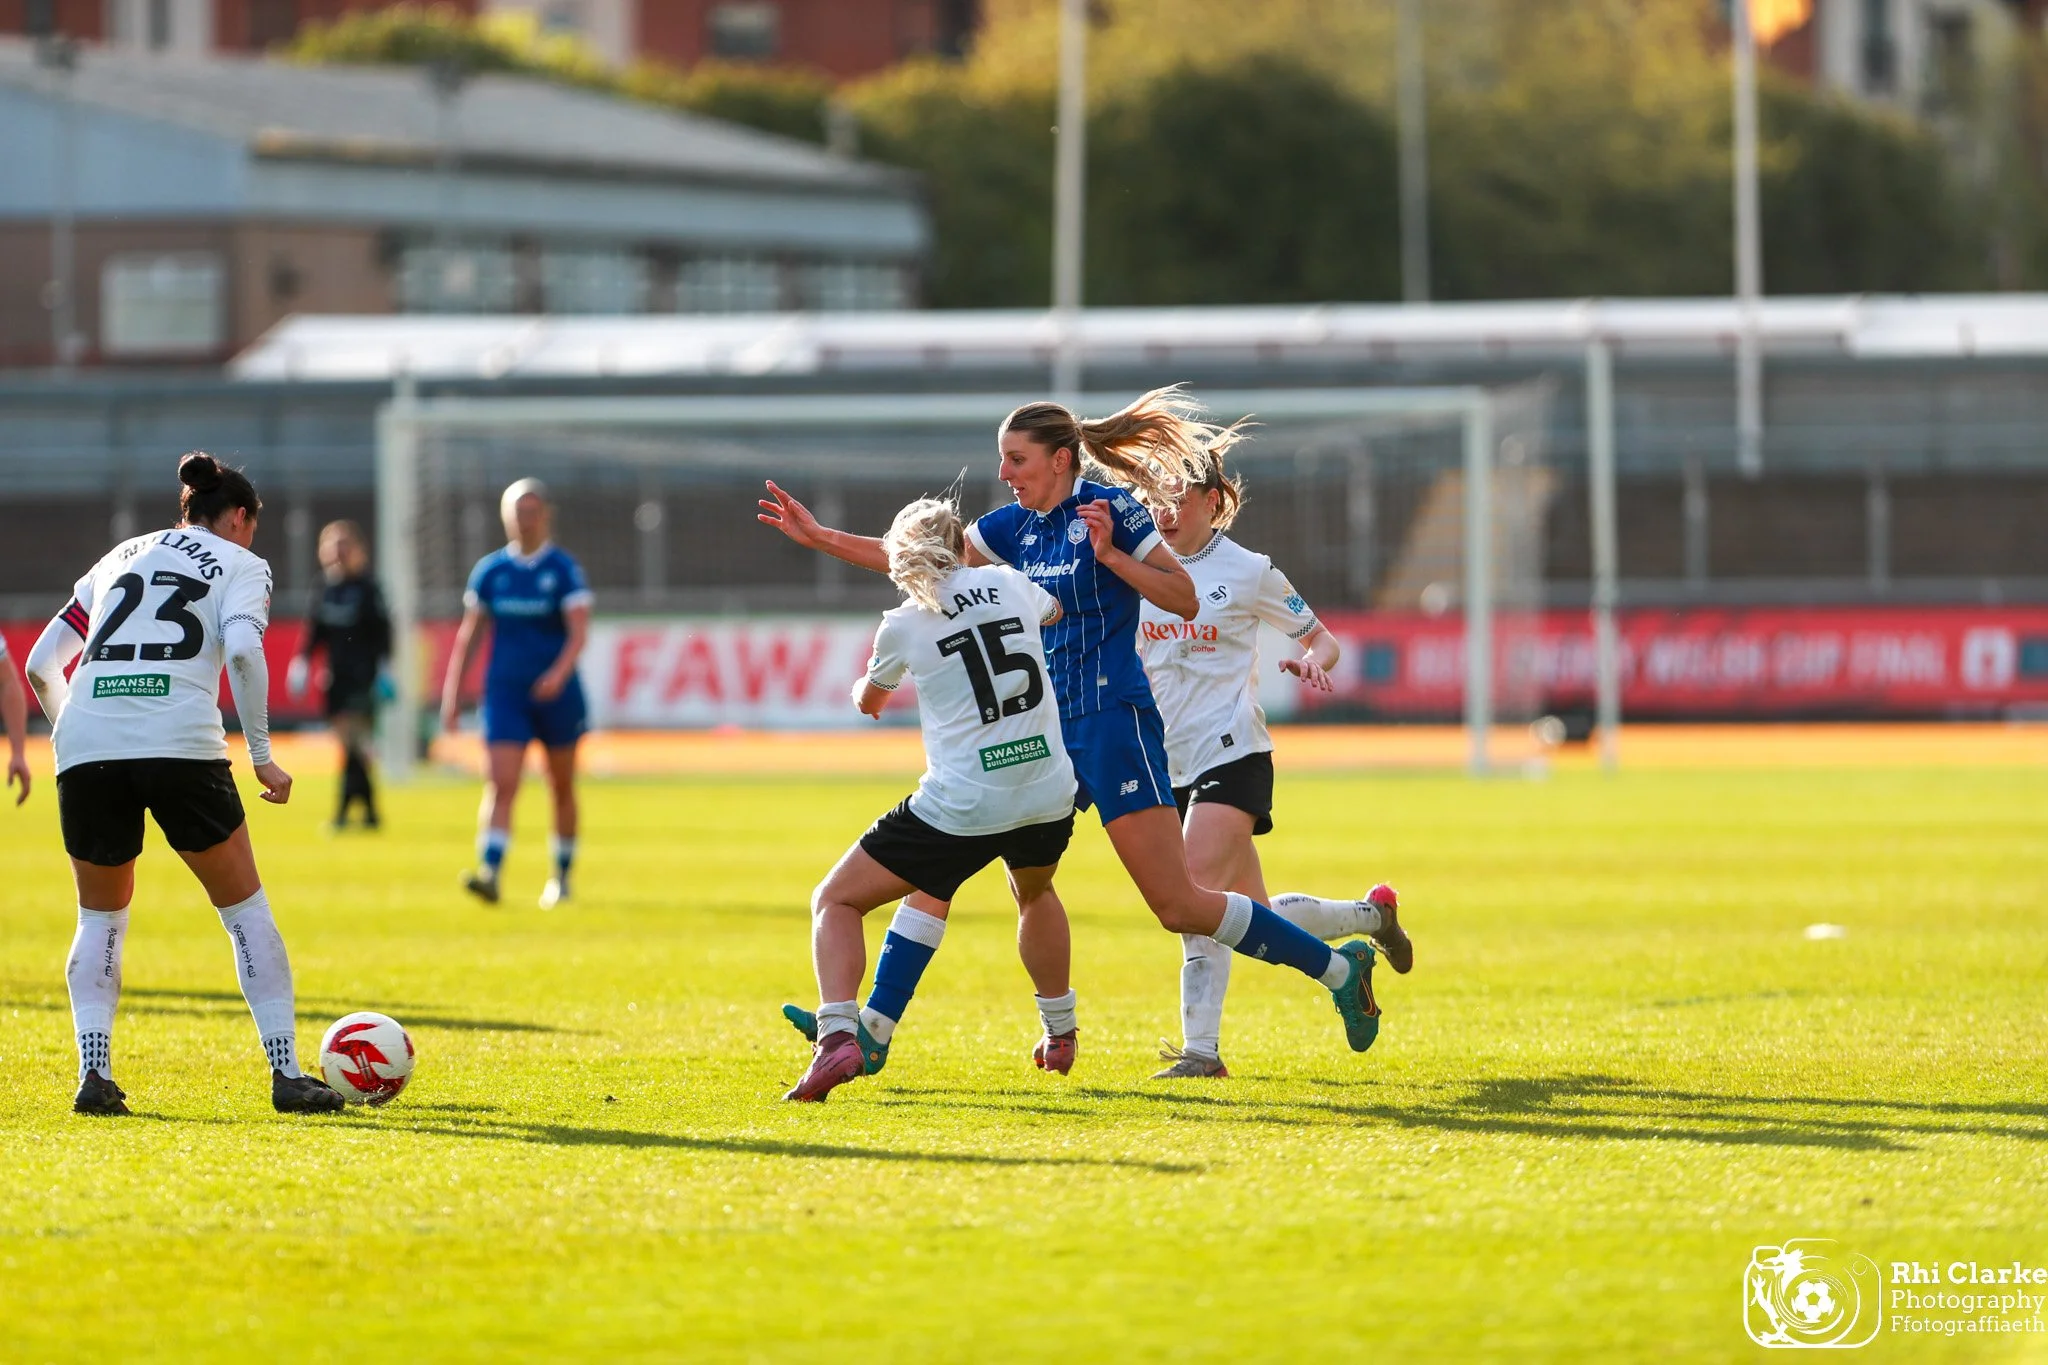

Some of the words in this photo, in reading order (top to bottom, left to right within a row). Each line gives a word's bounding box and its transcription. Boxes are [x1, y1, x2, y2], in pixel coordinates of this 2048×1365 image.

[942, 587, 1001, 620] LAKE
[81, 570, 211, 667] 23
[1141, 621, 1218, 641] Reviva
[1191, 645, 1216, 653] Coffee
[936, 616, 1044, 725] 15
[96, 687, 131, 696] BUILDING
[97, 677, 166, 689] SWANSEA
[984, 739, 1045, 761] SWANSEA
[986, 755, 1020, 768] BUILDING
[1020, 749, 1047, 760] SOCIETY
